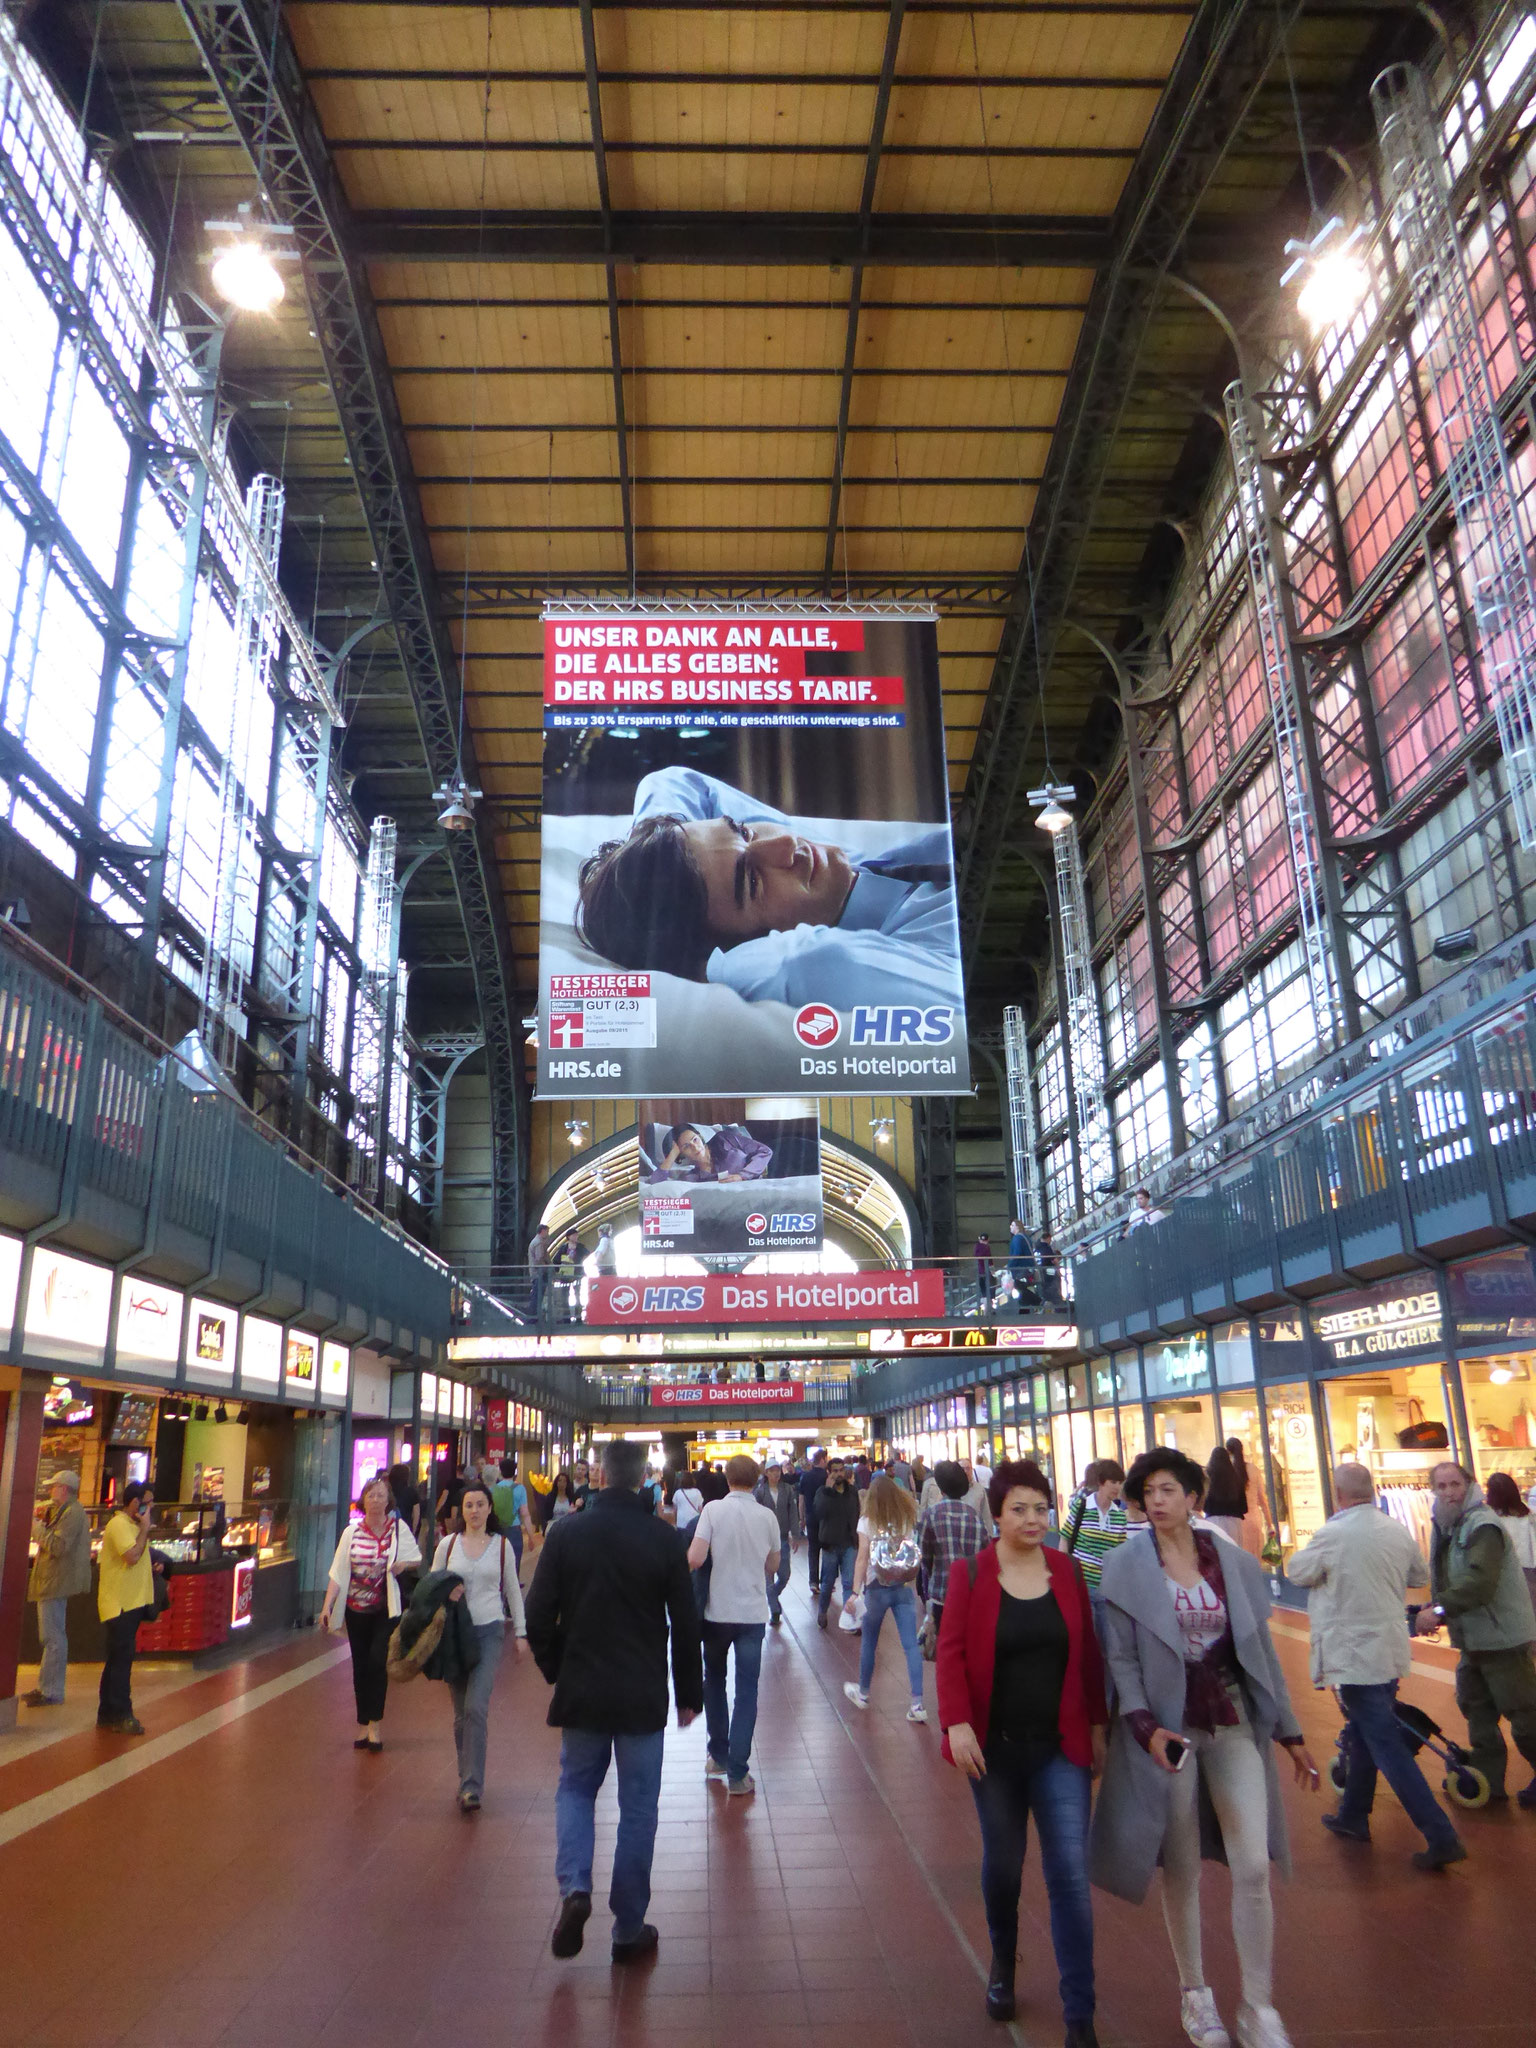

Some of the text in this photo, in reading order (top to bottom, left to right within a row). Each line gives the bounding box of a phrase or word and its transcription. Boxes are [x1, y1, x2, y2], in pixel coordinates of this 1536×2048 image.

[555, 627, 838, 650] UNSER DANK AN ALLE,
[555, 654, 779, 674] DIE ALLES GEBEN:
[554, 680, 878, 701] DER HRS BUSINESS TARIF.
[553, 715, 571, 726] Bis
[574, 717, 588, 726] zu
[617, 714, 673, 728] Ersparnis
[674, 714, 691, 726] für
[693, 714, 718, 727] alle,
[720, 714, 738, 726] die
[741, 714, 807, 729] geschäftlich
[810, 716, 869, 728] unterwegs
[871, 714, 900, 726] sind.
[552, 976, 648, 988] TESTSIEGER
[552, 989, 628, 998] HOTELPORTALE
[586, 1001, 639, 1012] GUT (2,3)
[850, 1006, 954, 1046] HRS
[549, 1060, 621, 1078] HRS.de
[800, 1056, 956, 1078] Das Hotelportal
[770, 1214, 816, 1232] HRS
[643, 1240, 674, 1248] HRS.de
[749, 1236, 816, 1246] Das Hotelportal
[642, 1280, 919, 1312] HRS Das Hotelportal
[1366, 1325, 1441, 1353] GÜLCHER
[675, 1386, 793, 1401] HRS Das Hotelportal
[1283, 1404, 1305, 1414] RICH
